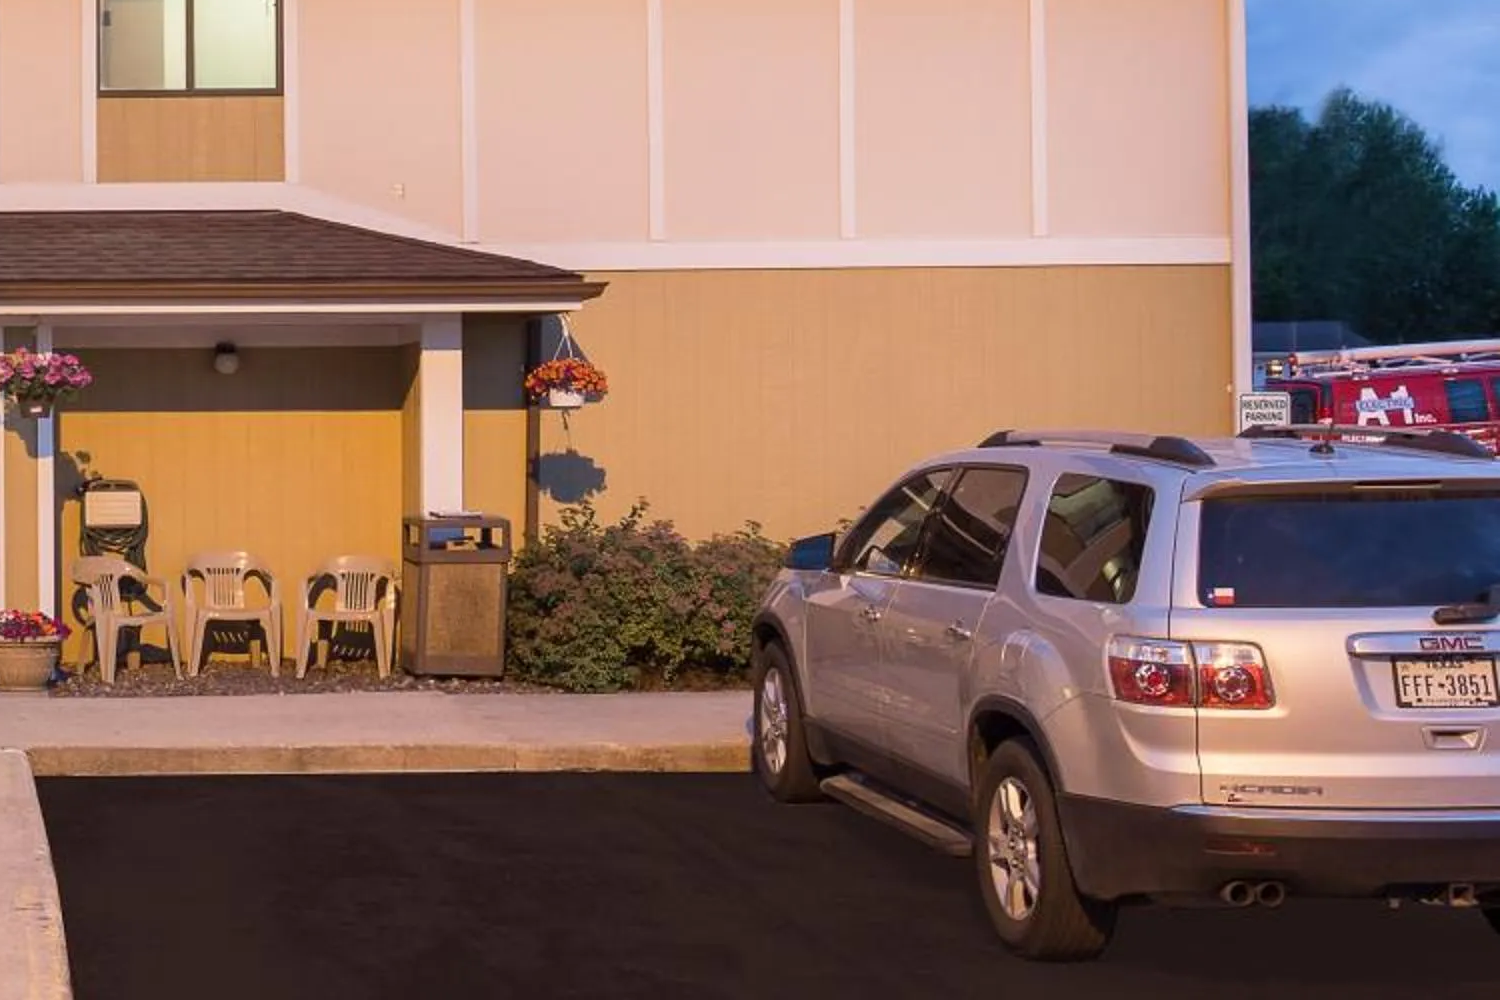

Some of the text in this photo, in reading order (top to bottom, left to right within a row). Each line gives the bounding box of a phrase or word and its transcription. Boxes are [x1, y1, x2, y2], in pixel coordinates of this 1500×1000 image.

[1242, 400, 1287, 410] RESERVED
[1245, 411, 1284, 422] PARKING
[1419, 637, 1485, 650] GMC
[1401, 674, 1492, 697] FFF-3851
